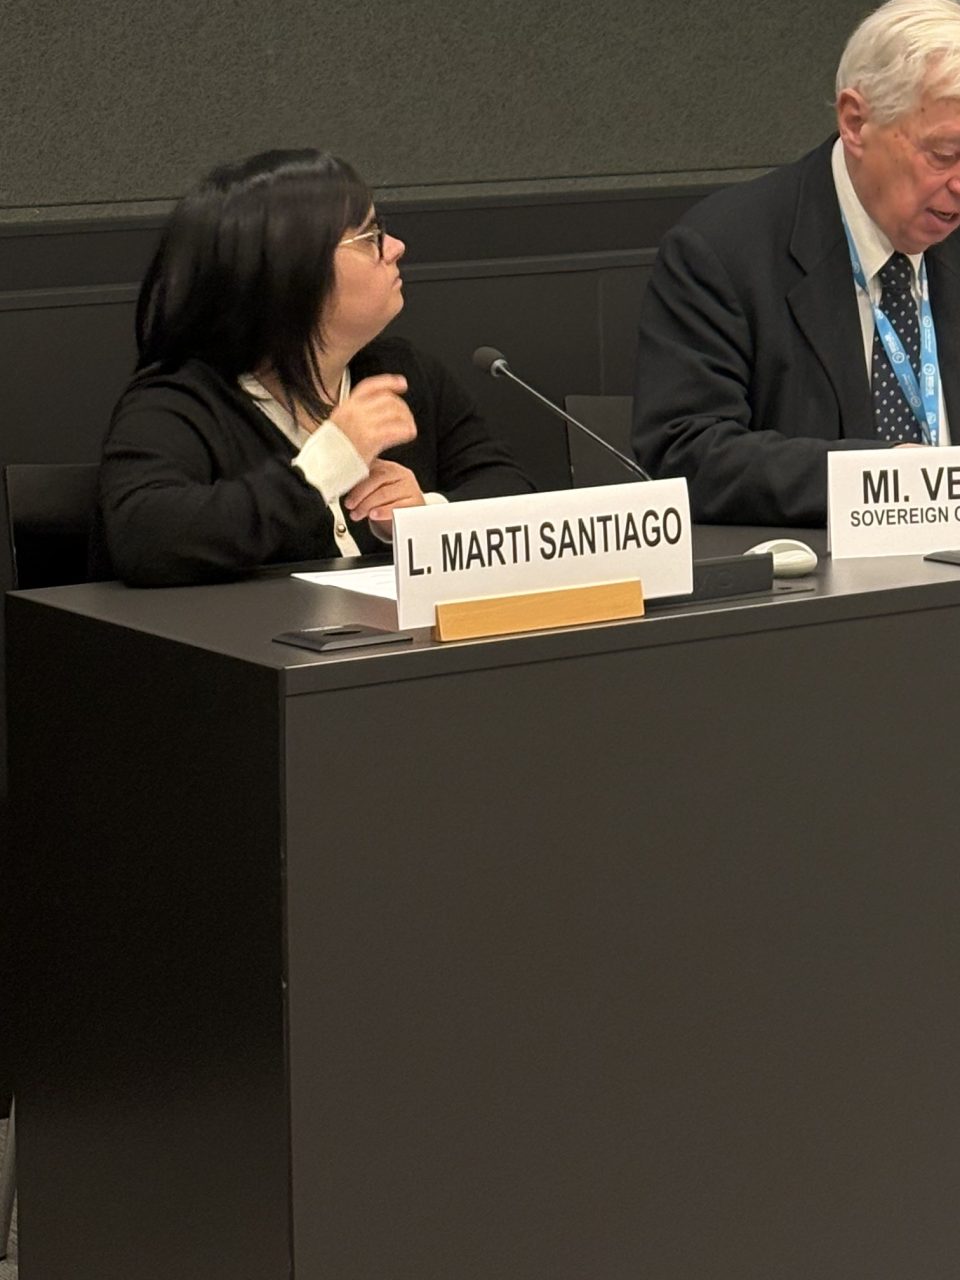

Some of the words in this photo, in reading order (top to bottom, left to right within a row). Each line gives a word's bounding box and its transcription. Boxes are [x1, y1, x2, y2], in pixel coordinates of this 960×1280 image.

[861, 469, 911, 504] MI.
[850, 506, 949, 528] SOVEREIGN
[407, 537, 433, 577] L.
[441, 524, 531, 573] MARTI
[539, 506, 683, 561] SANTIAGO
